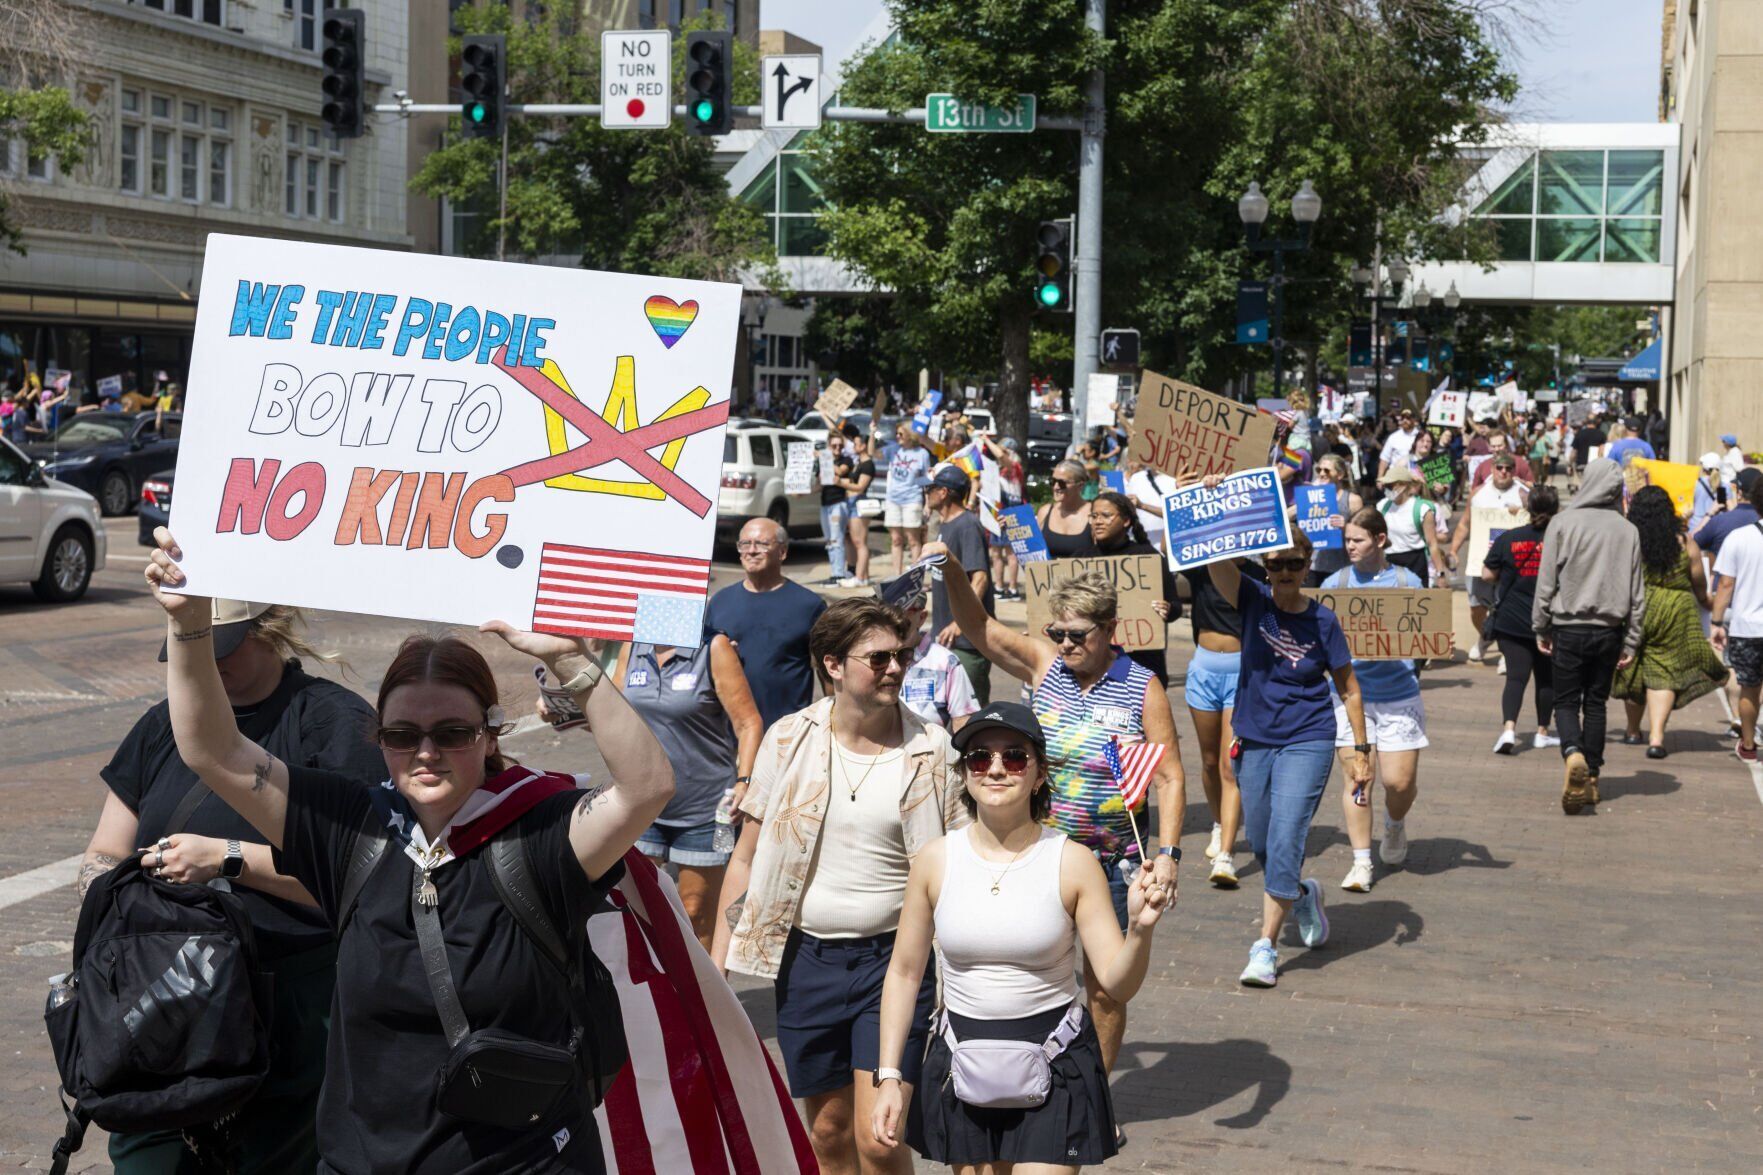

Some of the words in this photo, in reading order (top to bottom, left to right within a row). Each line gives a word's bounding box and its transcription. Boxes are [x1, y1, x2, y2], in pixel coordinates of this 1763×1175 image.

[622, 40, 651, 57] NO
[618, 63, 655, 77] TURN
[609, 83, 628, 96] ON
[636, 83, 663, 96] RED
[937, 98, 985, 127] 13th
[998, 103, 1024, 127] St
[229, 279, 306, 338] WE
[311, 290, 398, 348] THE
[248, 362, 414, 448] BOW
[417, 378, 503, 454] TO
[1158, 382, 1257, 436] DEPORT
[1168, 414, 1240, 462] WHITE
[1138, 428, 1235, 481] SUPREMA
[215, 457, 327, 541] NO
[1169, 473, 1272, 512] REJECTING
[1192, 492, 1253, 521] KINGS
[1307, 489, 1326, 503] WE
[1298, 517, 1334, 532] PEOPL
[1181, 536, 1237, 562] SINCE
[1240, 527, 1278, 547] 1776
[1072, 556, 1152, 591] RUSE
[1316, 594, 1336, 612] O
[1349, 596, 1384, 616] ONE
[1402, 597, 1431, 616] IS
[1341, 615, 1387, 632] LEGAL
[1397, 615, 1422, 632] ON
[1399, 632, 1450, 656] LAND
